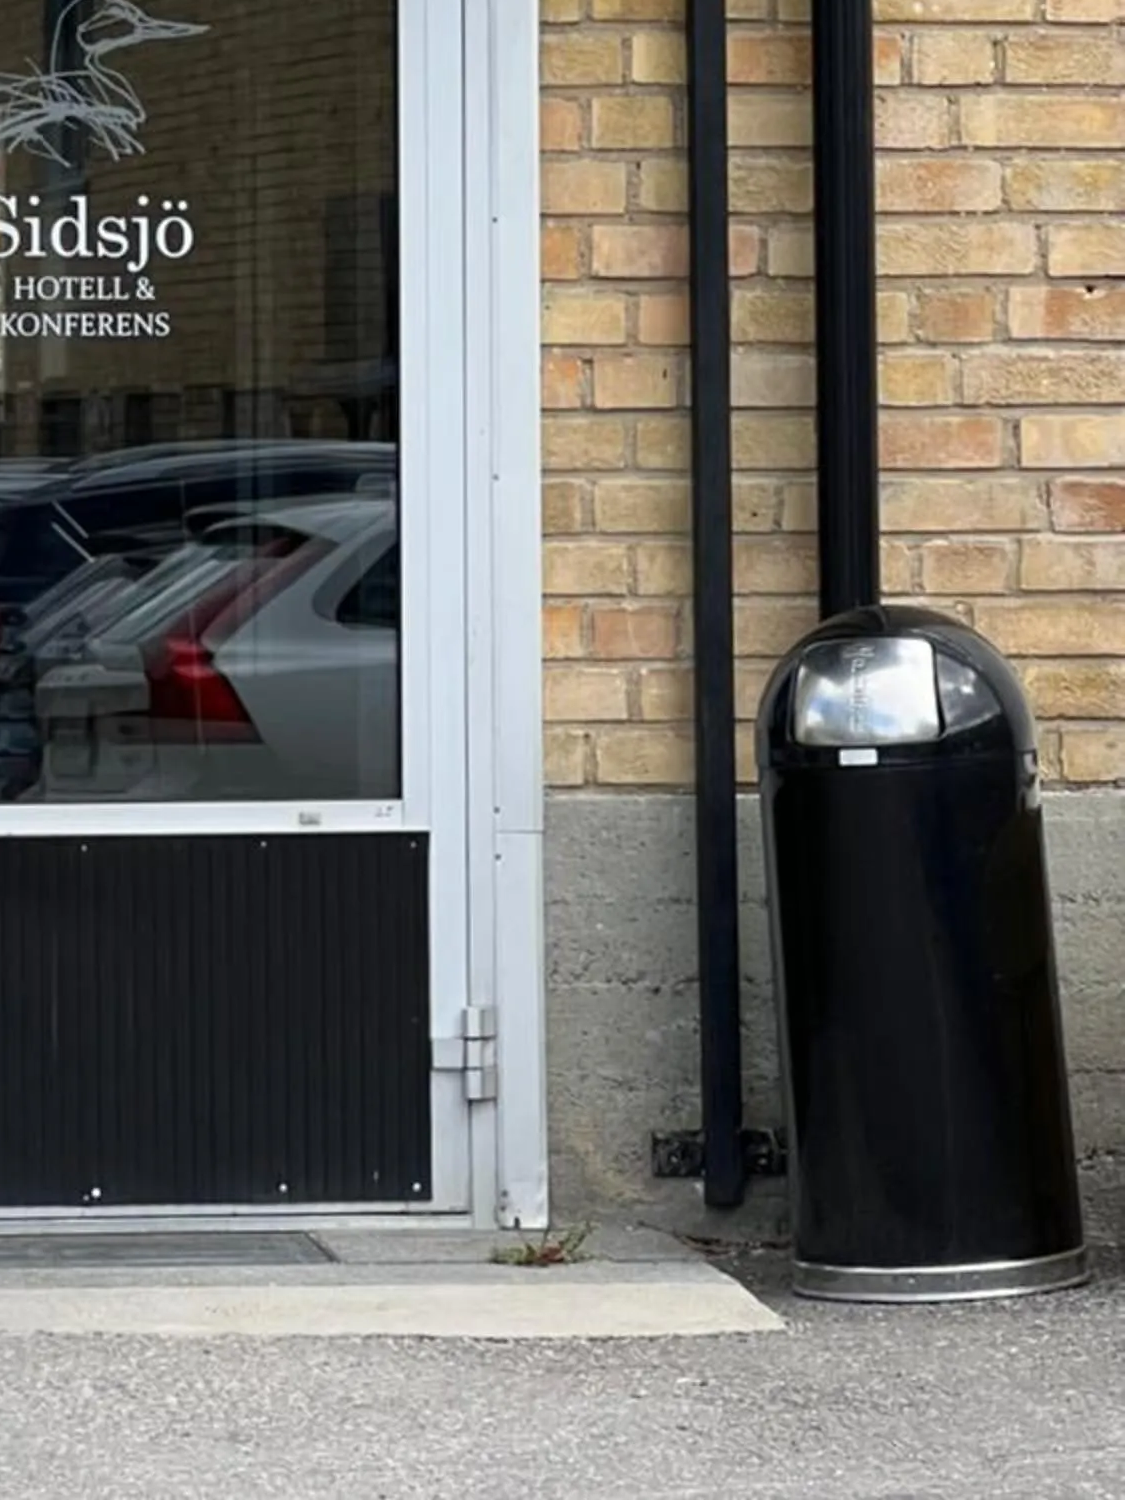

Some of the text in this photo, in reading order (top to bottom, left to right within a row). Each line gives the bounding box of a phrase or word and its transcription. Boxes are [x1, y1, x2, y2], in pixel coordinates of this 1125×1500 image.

[14, 276, 156, 300] HOTELL &
[0, 312, 171, 337] KONFERENS
